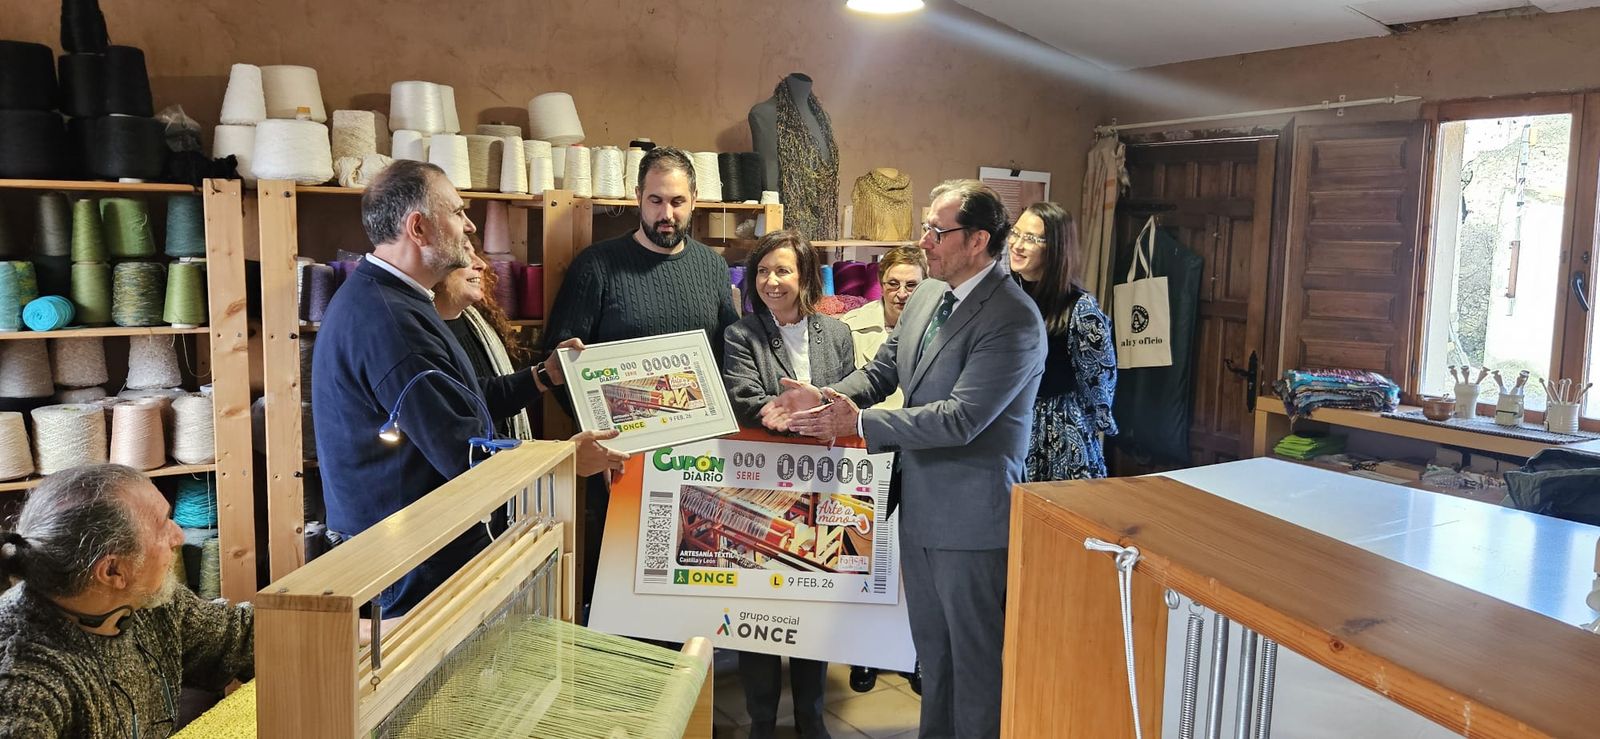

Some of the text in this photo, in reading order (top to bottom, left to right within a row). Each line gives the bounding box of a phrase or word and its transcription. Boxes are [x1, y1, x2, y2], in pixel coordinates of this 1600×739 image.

[620, 361, 637, 371] 000
[641, 352, 691, 372] 00000
[623, 421, 645, 431] ONCE
[652, 446, 725, 473] CUPÓN
[733, 452, 766, 468] 000
[736, 471, 761, 480] SERIE
[776, 453, 874, 485] 00000
[819, 500, 843, 514] Arte
[818, 514, 849, 523] mano
[692, 572, 735, 584] ONCE
[773, 576, 834, 588] L 9 FEB. 26
[739, 611, 800, 625] grupo social
[737, 622, 798, 645] ONCE
